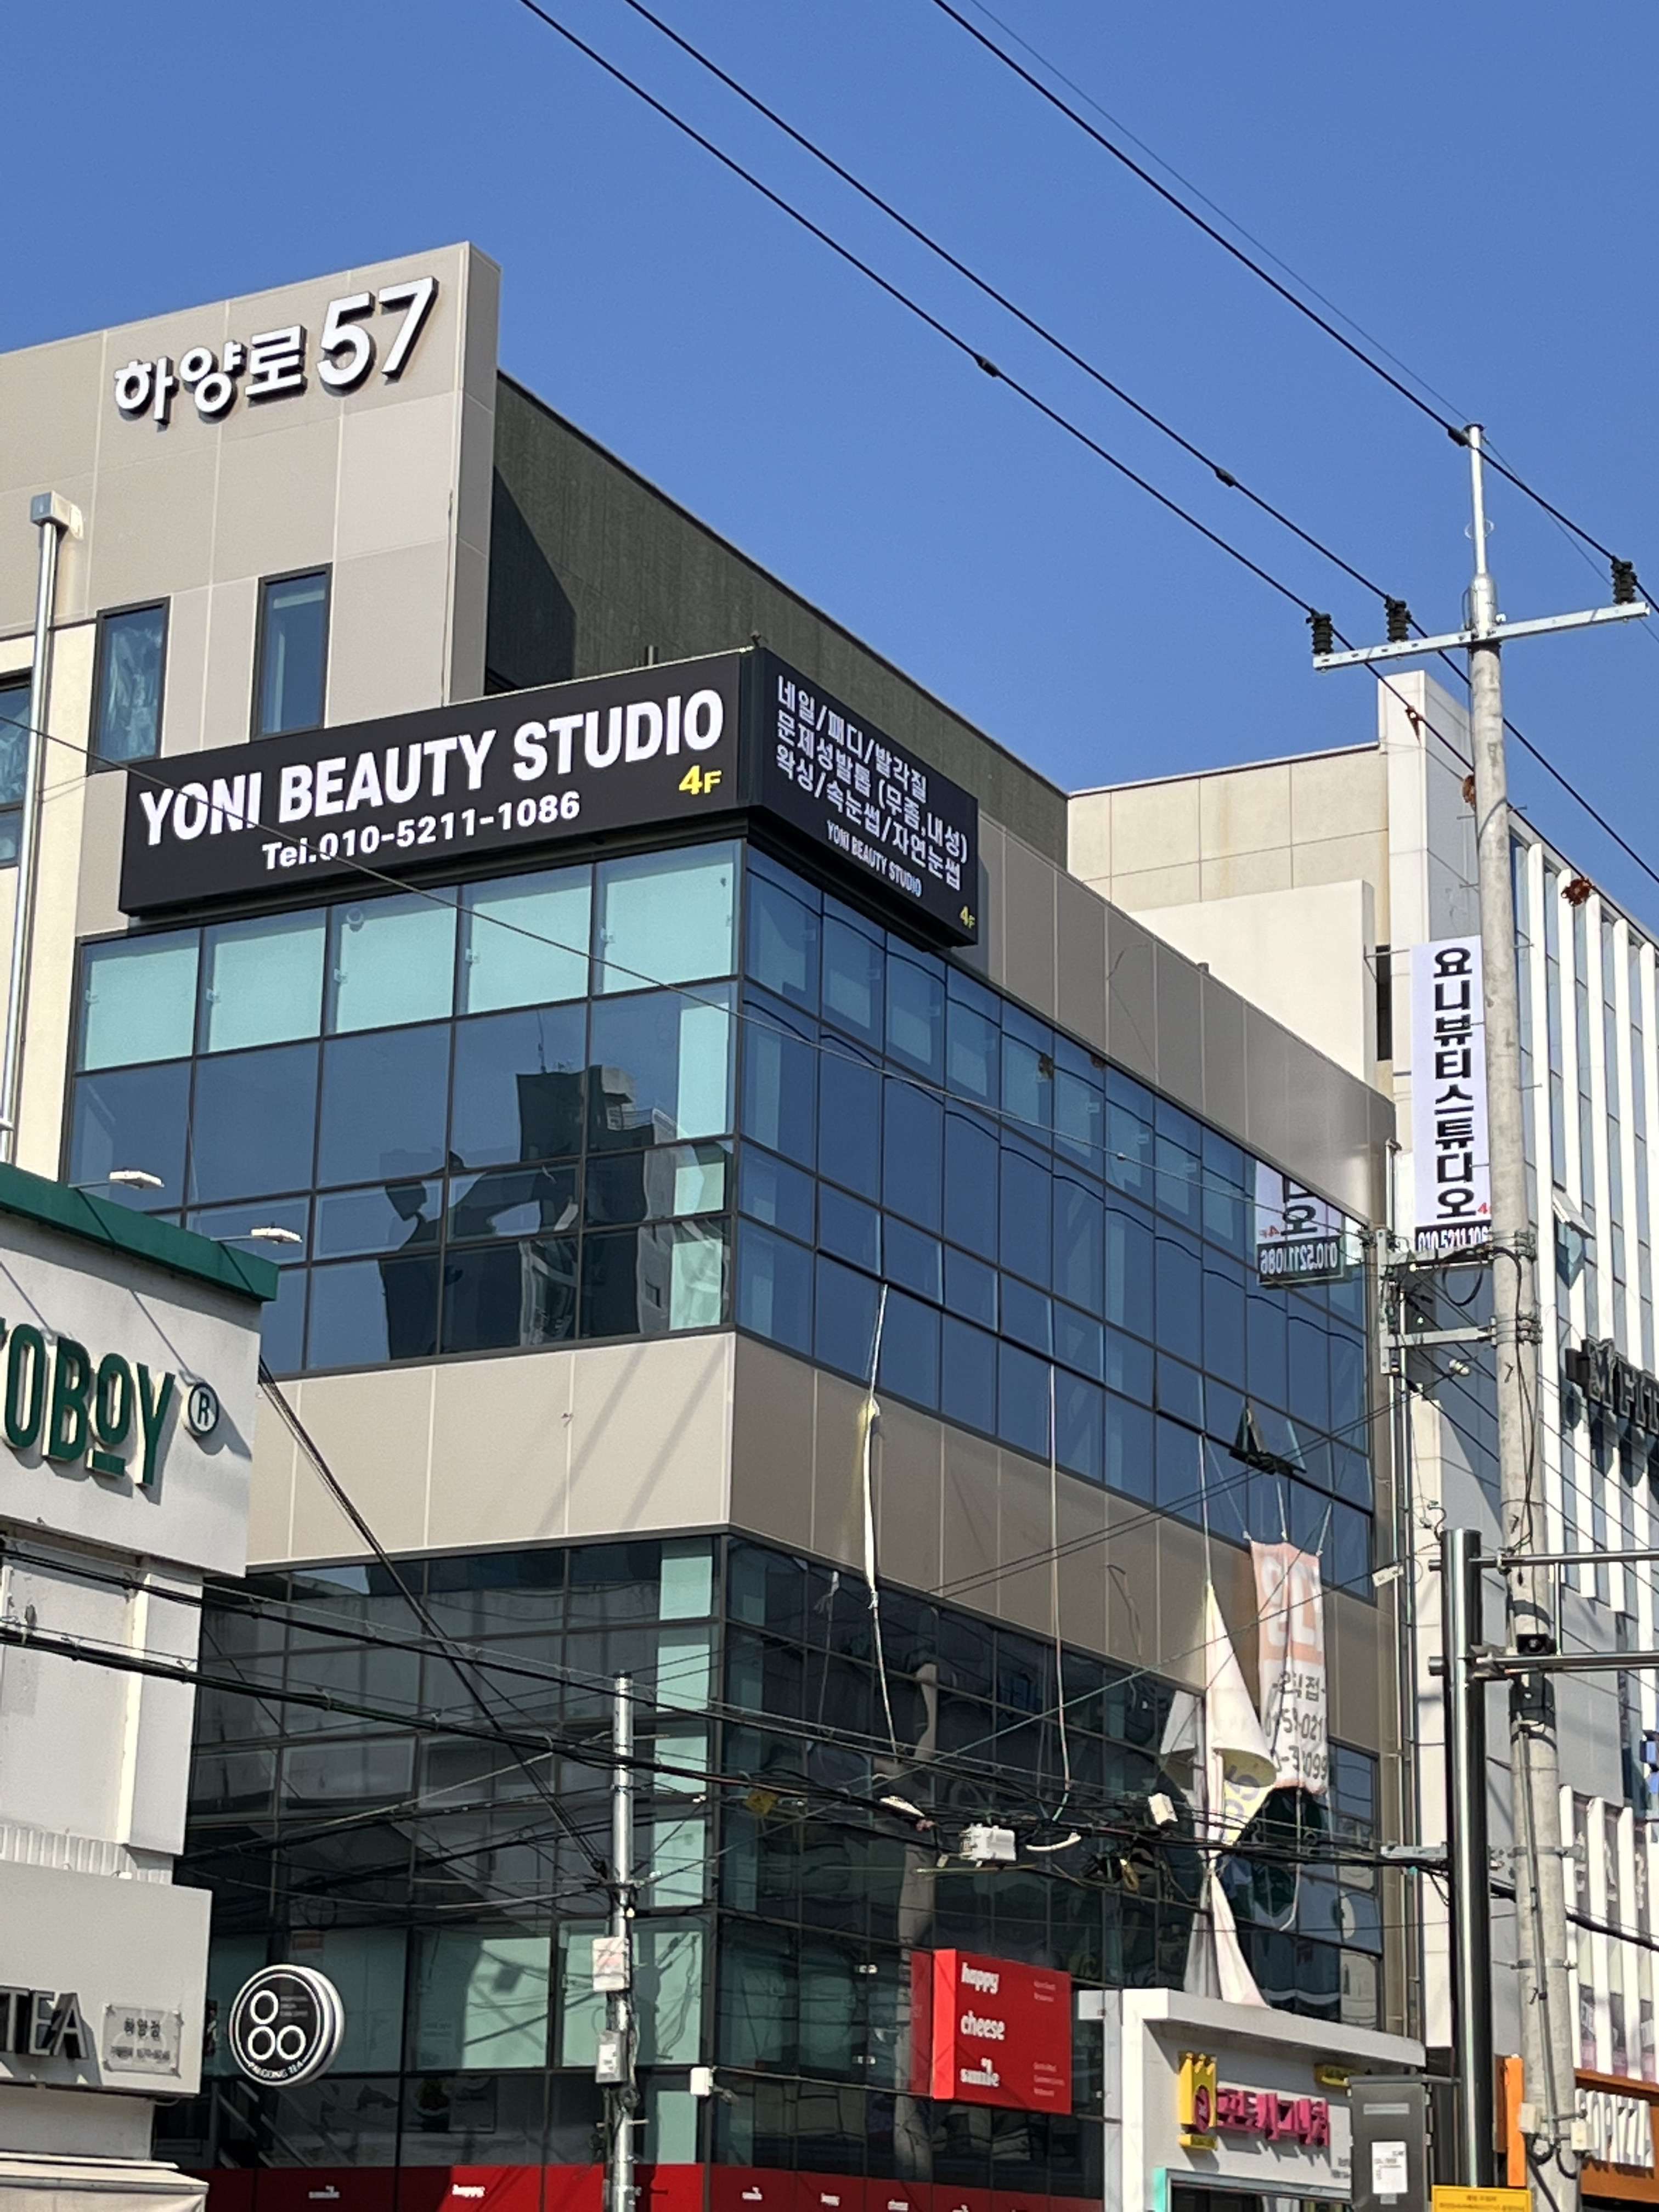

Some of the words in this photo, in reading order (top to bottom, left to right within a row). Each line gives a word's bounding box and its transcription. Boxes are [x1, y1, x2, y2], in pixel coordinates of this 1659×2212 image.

[114, 325, 307, 425] 하양로
[317, 276, 439, 391] 57
[139, 772, 263, 846] YONI
[279, 730, 496, 824] BEAUTY
[513, 689, 724, 782] STUDIO
[678, 765, 723, 795] 4F
[851, 835, 888, 875] BEAUTY
[888, 861, 922, 898] STUDIO
[1433, 947, 1477, 1219] 요니뷰티스튜디오
[0, 1318, 176, 1486] OBOY
[961, 1962, 1000, 1995] happy
[961, 2010, 1006, 2041] cheese
